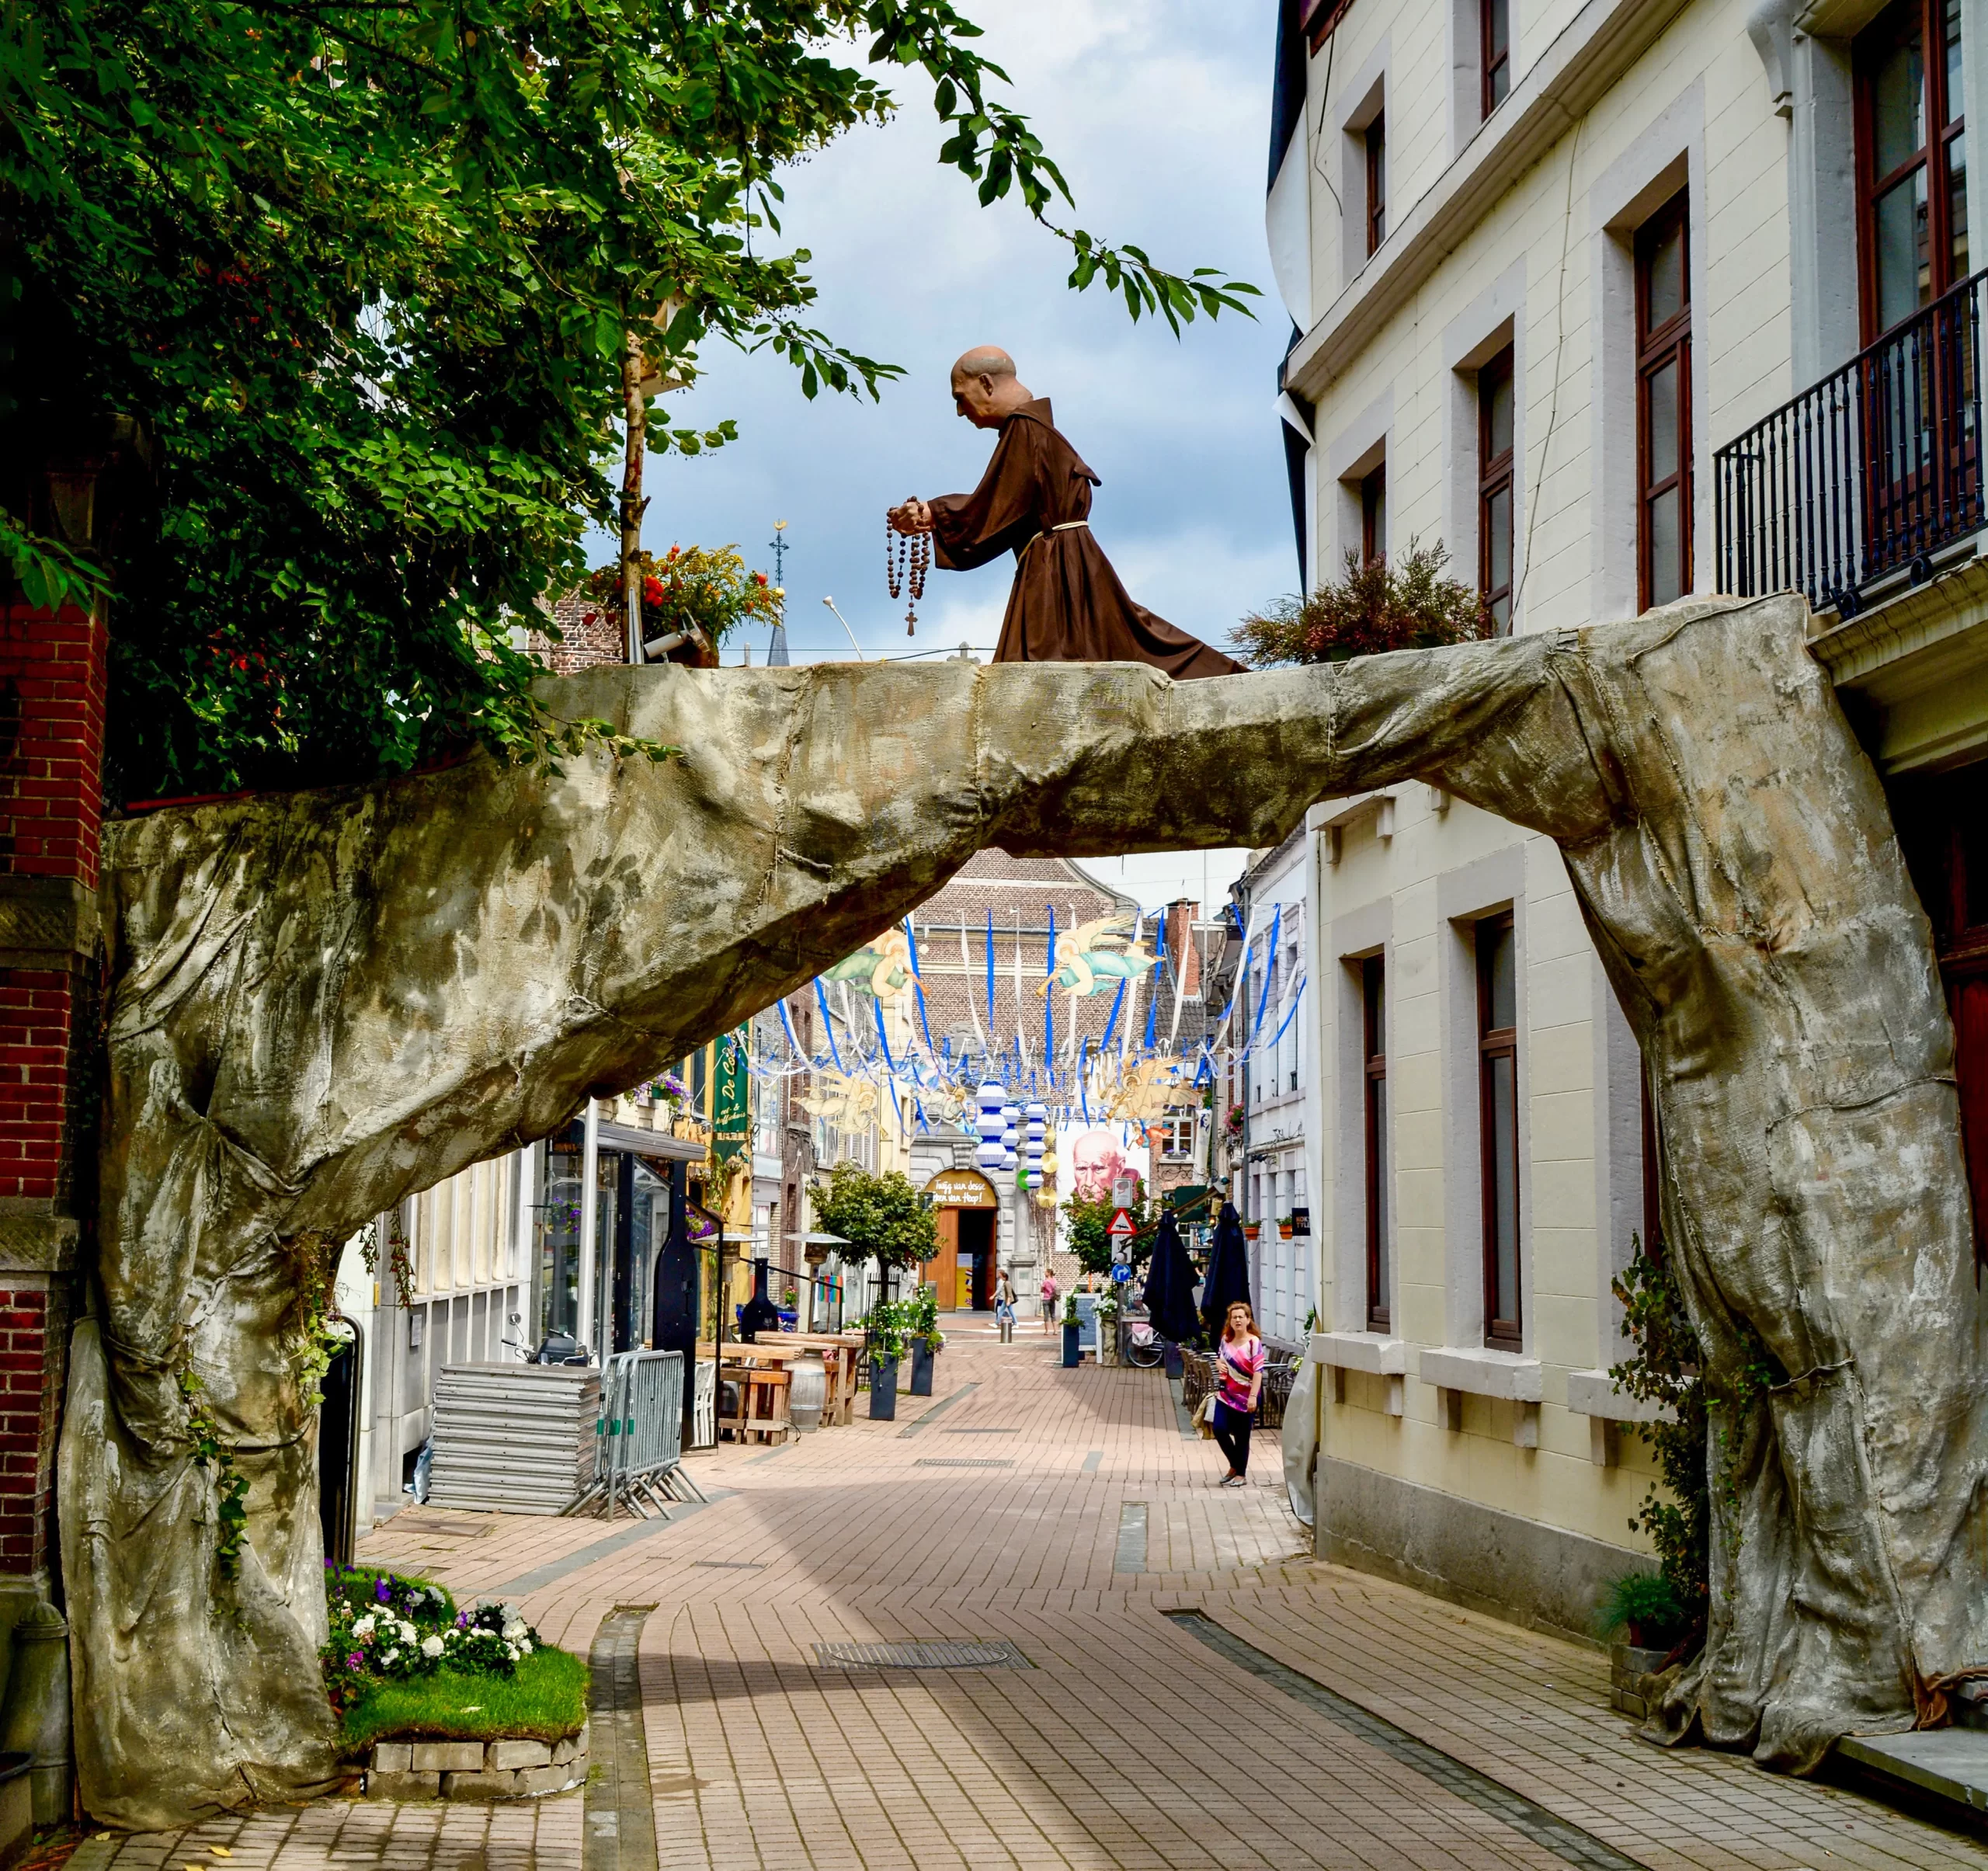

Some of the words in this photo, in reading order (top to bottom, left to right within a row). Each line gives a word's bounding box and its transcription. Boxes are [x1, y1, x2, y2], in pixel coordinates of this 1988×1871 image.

[721, 1079, 735, 1101] De
[733, 1103, 740, 1111] &
[715, 1111, 746, 1125] koffiehuis
[948, 1194, 961, 1202] van
